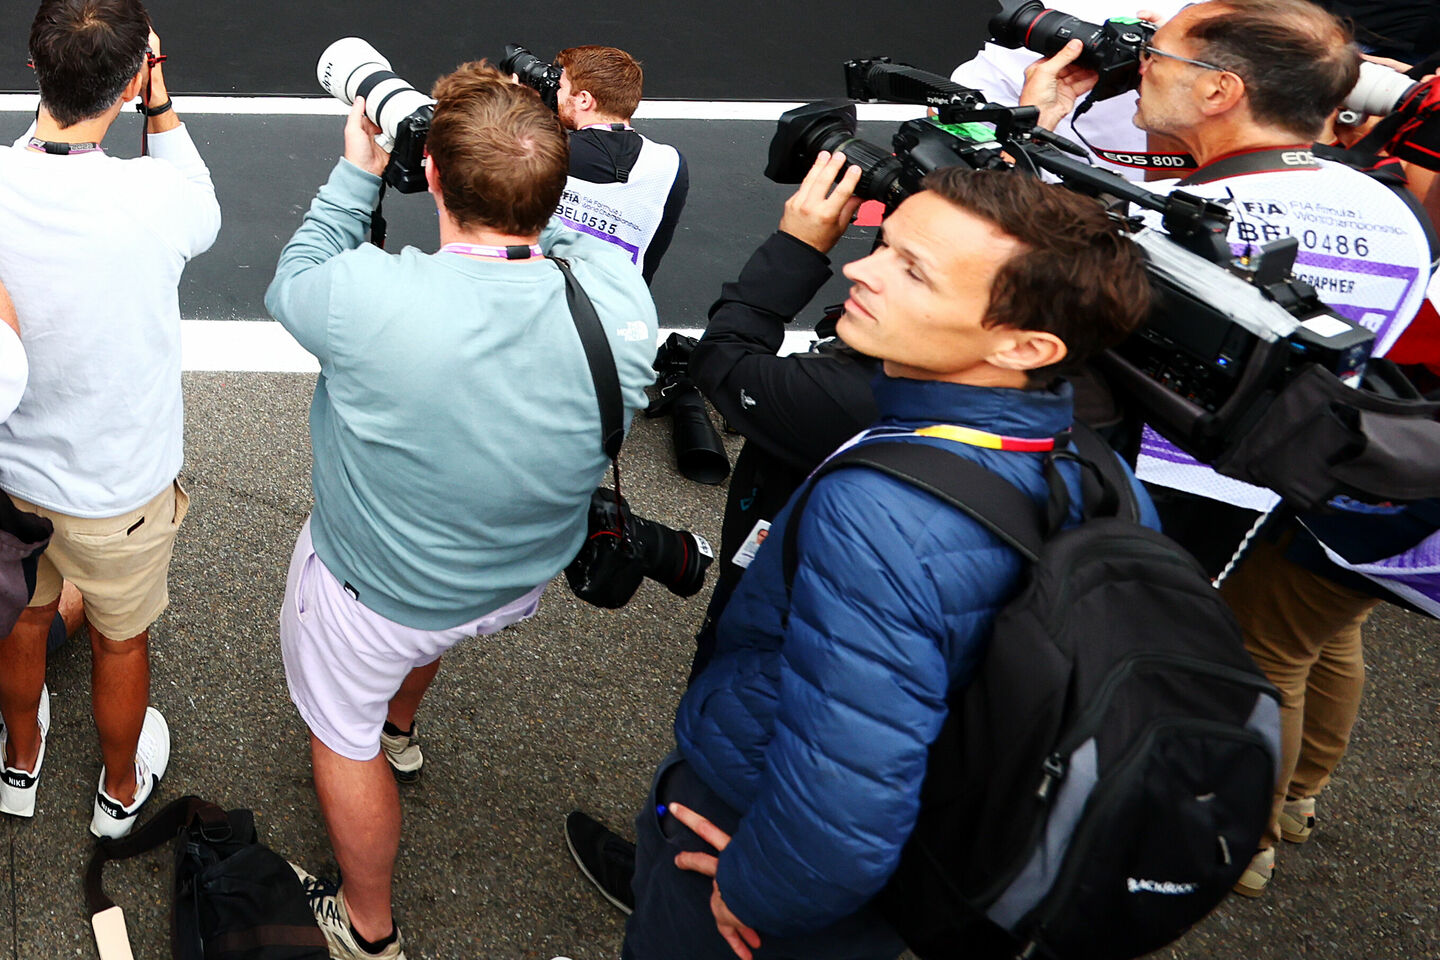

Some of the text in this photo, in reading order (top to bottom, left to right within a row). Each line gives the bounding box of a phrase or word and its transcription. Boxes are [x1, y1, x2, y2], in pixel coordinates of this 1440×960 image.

[926, 95, 951, 106] zylight
[1103, 152, 1185, 168] EOS 80D
[1243, 201, 1286, 216] FIA
[8, 776, 26, 787] NIKE
[101, 801, 118, 817] NIKE
